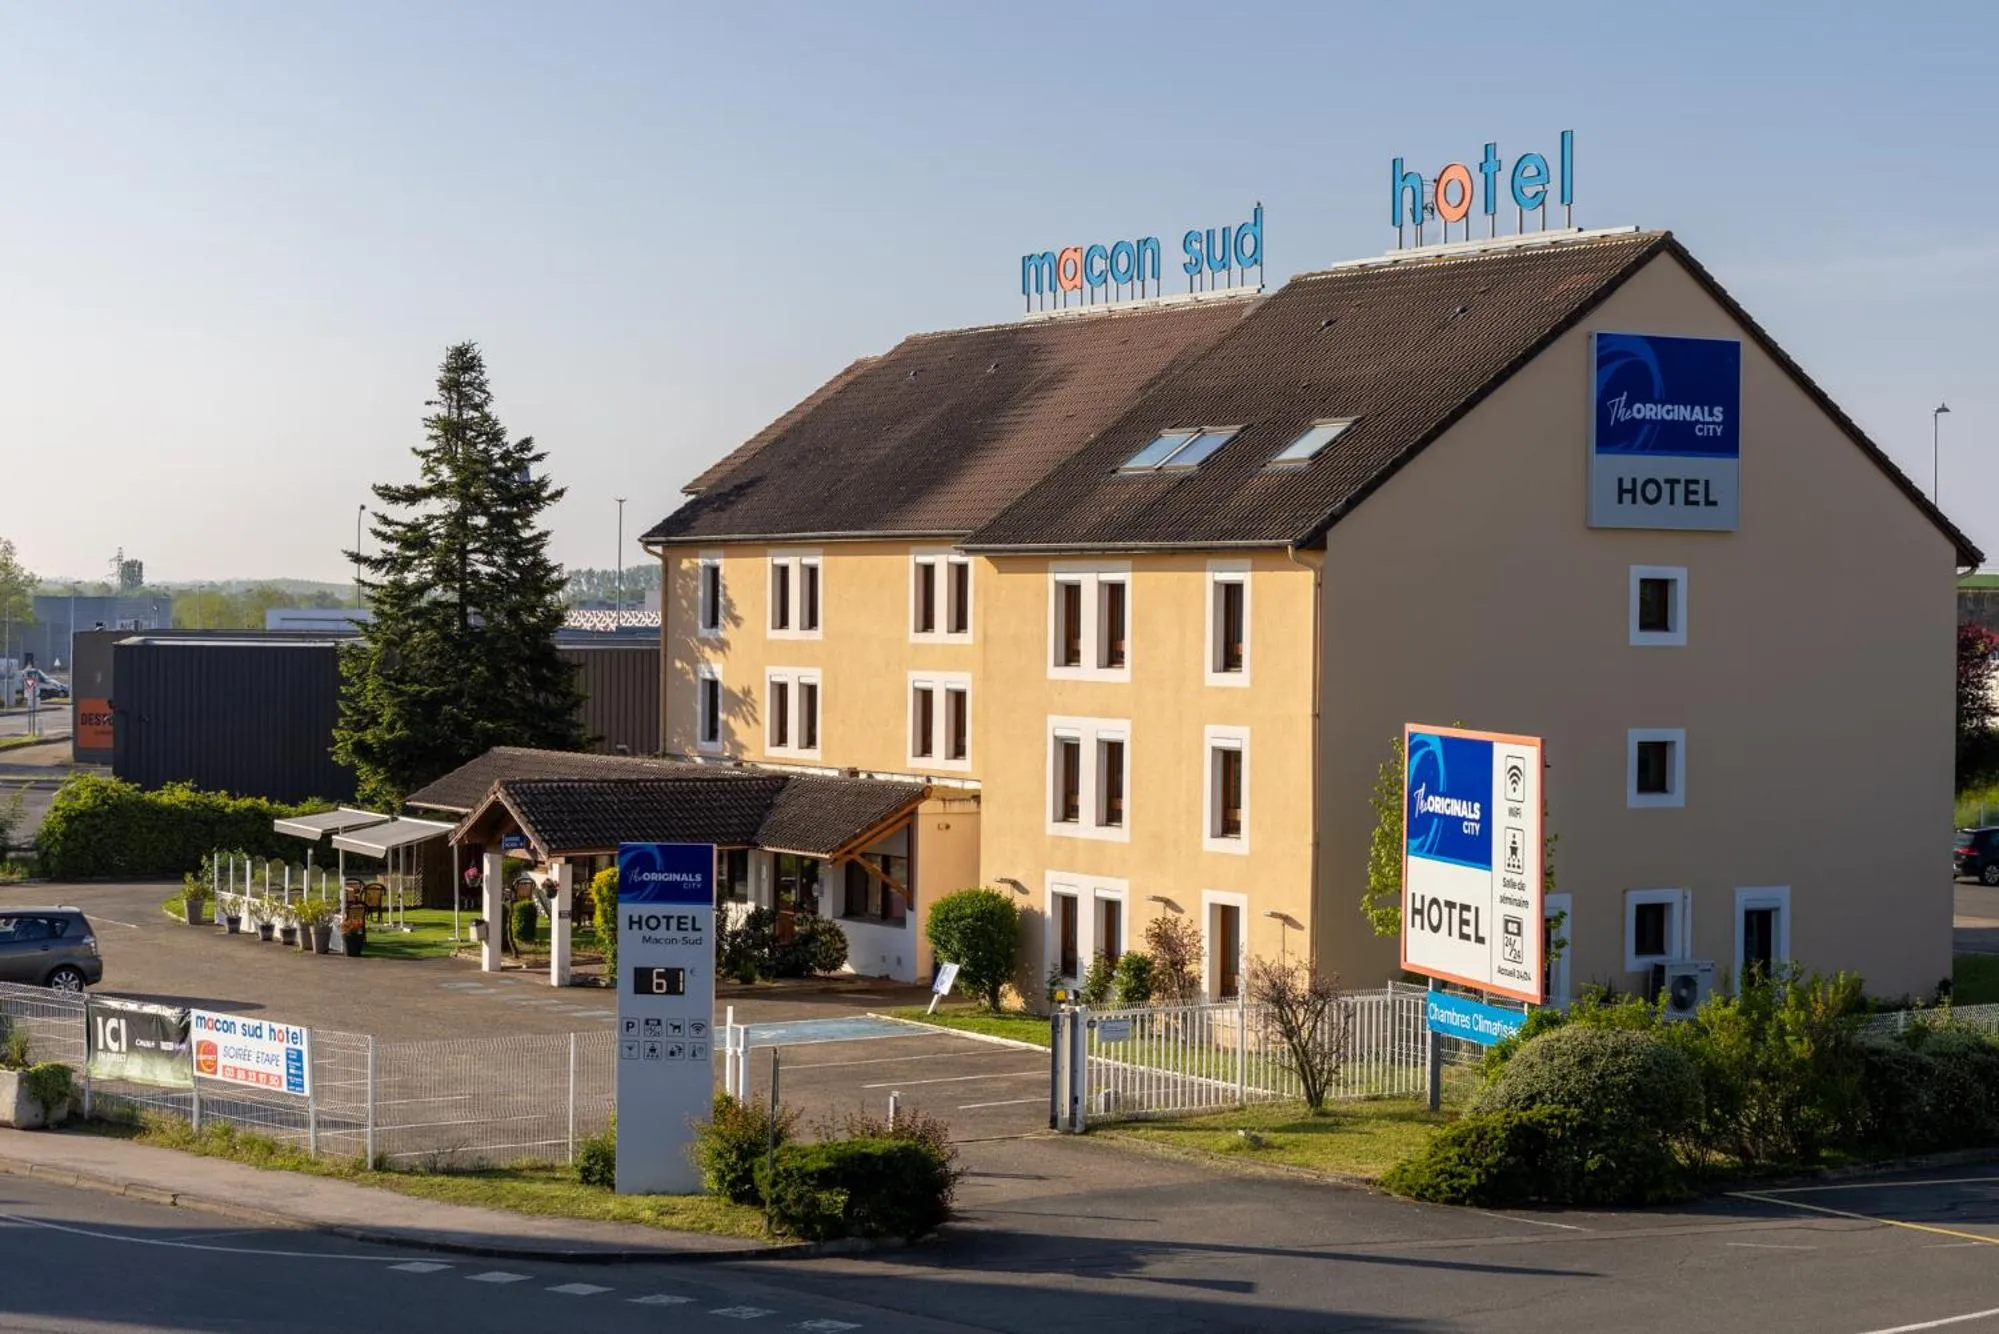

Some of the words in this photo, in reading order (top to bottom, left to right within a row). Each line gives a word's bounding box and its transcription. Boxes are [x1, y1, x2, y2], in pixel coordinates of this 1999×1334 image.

[1022, 236, 1161, 295] macon
[1183, 205, 1263, 276] sud
[1392, 130, 1573, 227] hotel
[1607, 391, 1632, 426] The
[1632, 403, 1724, 422] ORIGINALS
[1695, 424, 1723, 436] CITY
[1617, 476, 1718, 506] HOTEL
[1426, 795, 1481, 820] ORIGINALS
[1463, 821, 1481, 837] CITY
[642, 872, 702, 882] ORIGINALS
[628, 914, 702, 932] HOTEL
[1411, 892, 1486, 945] HOTEL
[642, 935, 703, 946] Macon-Sud
[652, 968, 683, 994] 61
[1429, 1003, 1471, 1029] Chambres
[97, 1016, 127, 1053] ICI
[196, 1015, 236, 1034] macon
[241, 1022, 263, 1039] sud
[269, 1024, 303, 1045] hotel
